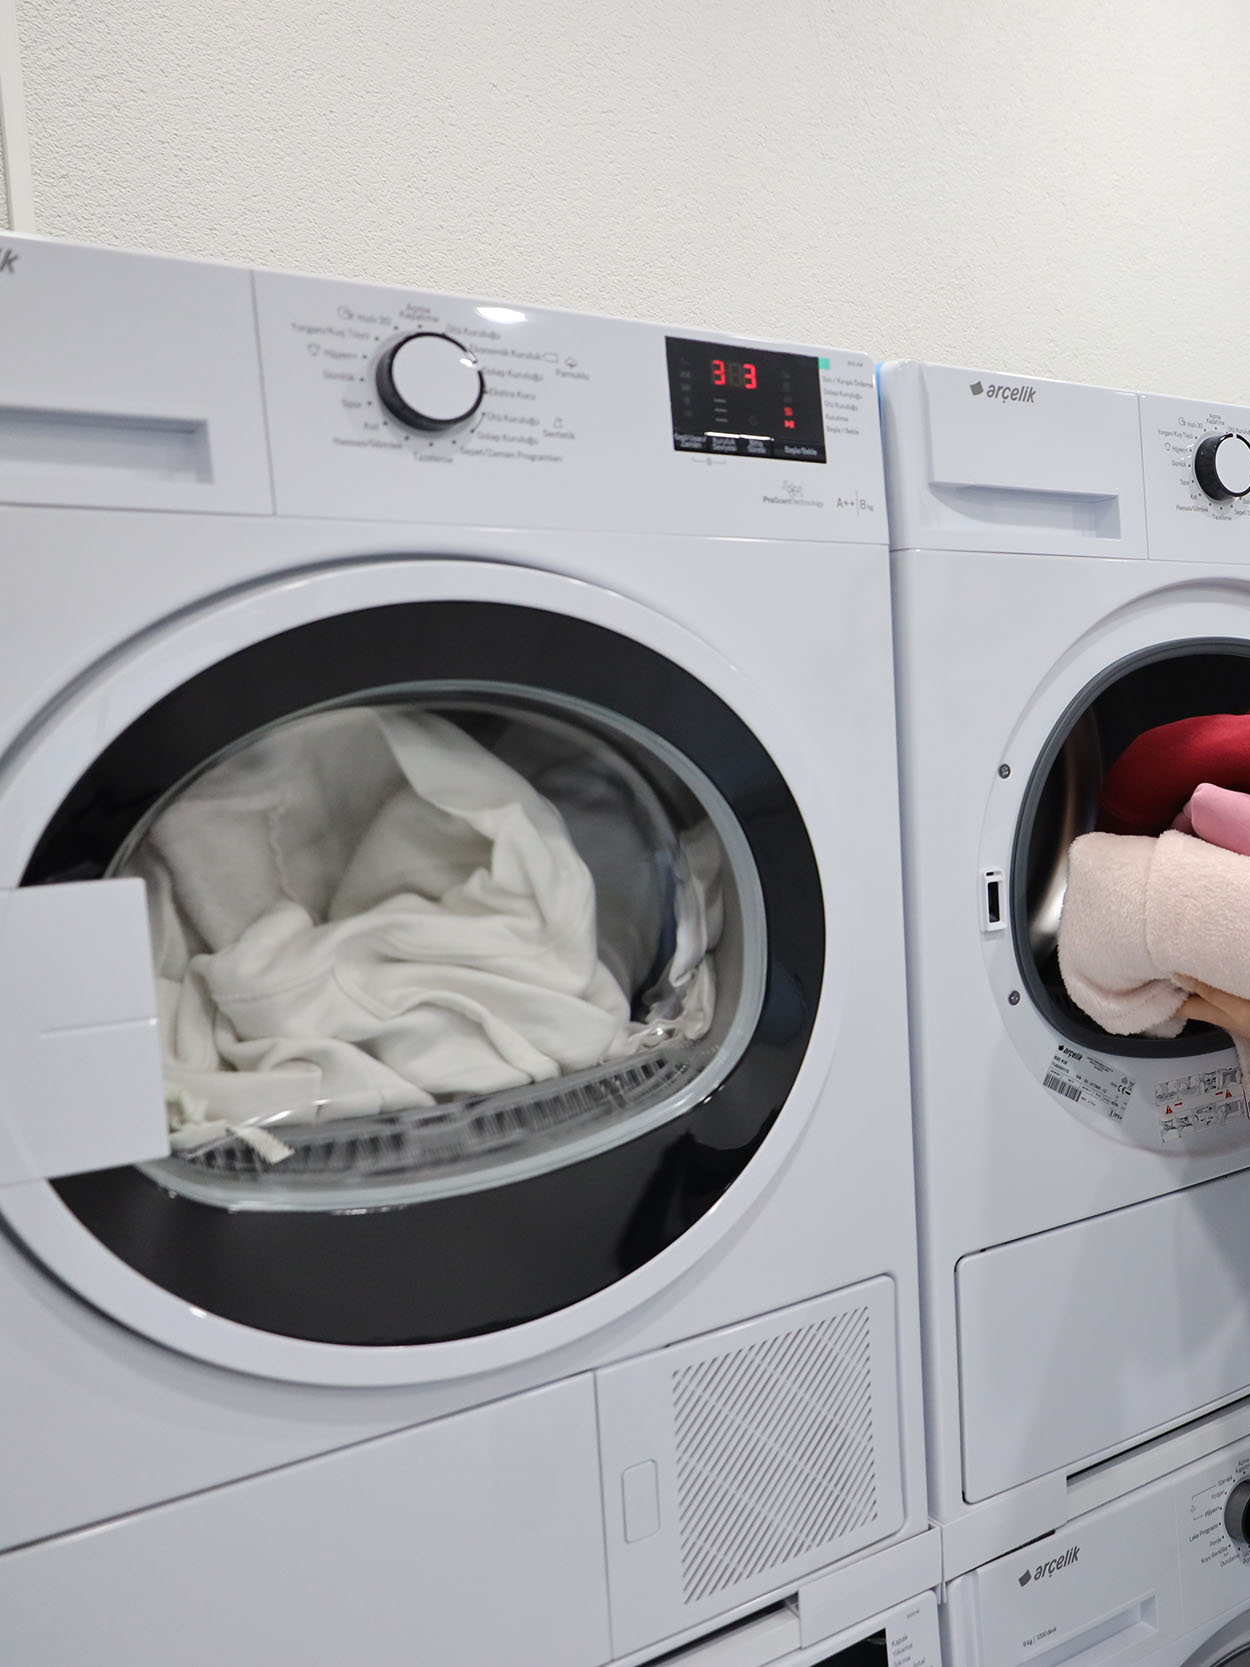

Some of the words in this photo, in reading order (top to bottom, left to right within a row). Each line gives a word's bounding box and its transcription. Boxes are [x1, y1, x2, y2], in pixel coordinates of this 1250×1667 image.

[986, 383, 1037, 404] arçelik
[1063, 1047, 1083, 1061] arçelik
[1034, 1545, 1080, 1581] arçelik
